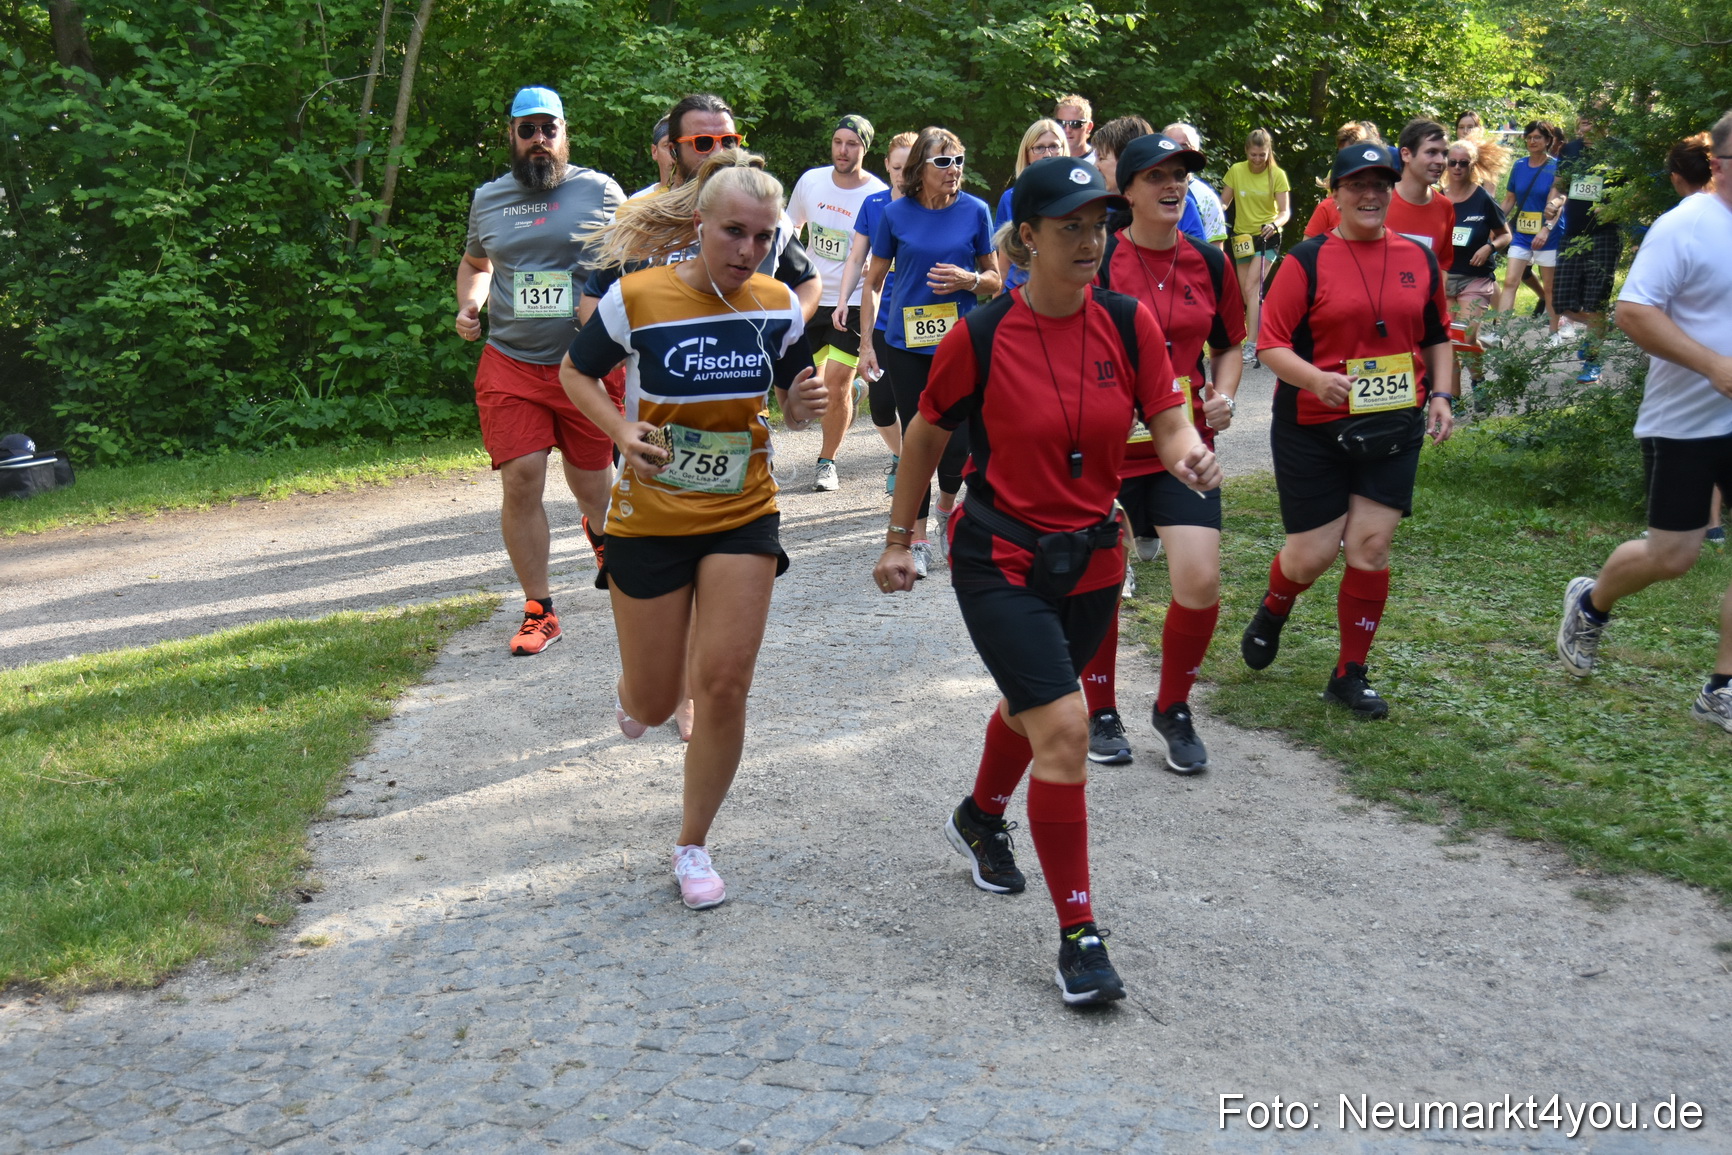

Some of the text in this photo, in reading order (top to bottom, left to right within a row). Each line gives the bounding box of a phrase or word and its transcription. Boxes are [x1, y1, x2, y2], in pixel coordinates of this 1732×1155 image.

[1574, 183, 1598, 194] 1383
[1519, 219, 1537, 228] 1141
[814, 235, 840, 253] 1191
[1399, 272, 1415, 283] 28
[520, 288, 564, 305] 1317
[1184, 285, 1194, 300] 2
[915, 318, 947, 336] 863
[684, 350, 766, 372] Fischer
[693, 369, 761, 381] AUTOMOBILE
[1094, 361, 1115, 381] 10
[1357, 373, 1409, 398] 2354
[679, 449, 729, 477] 758
